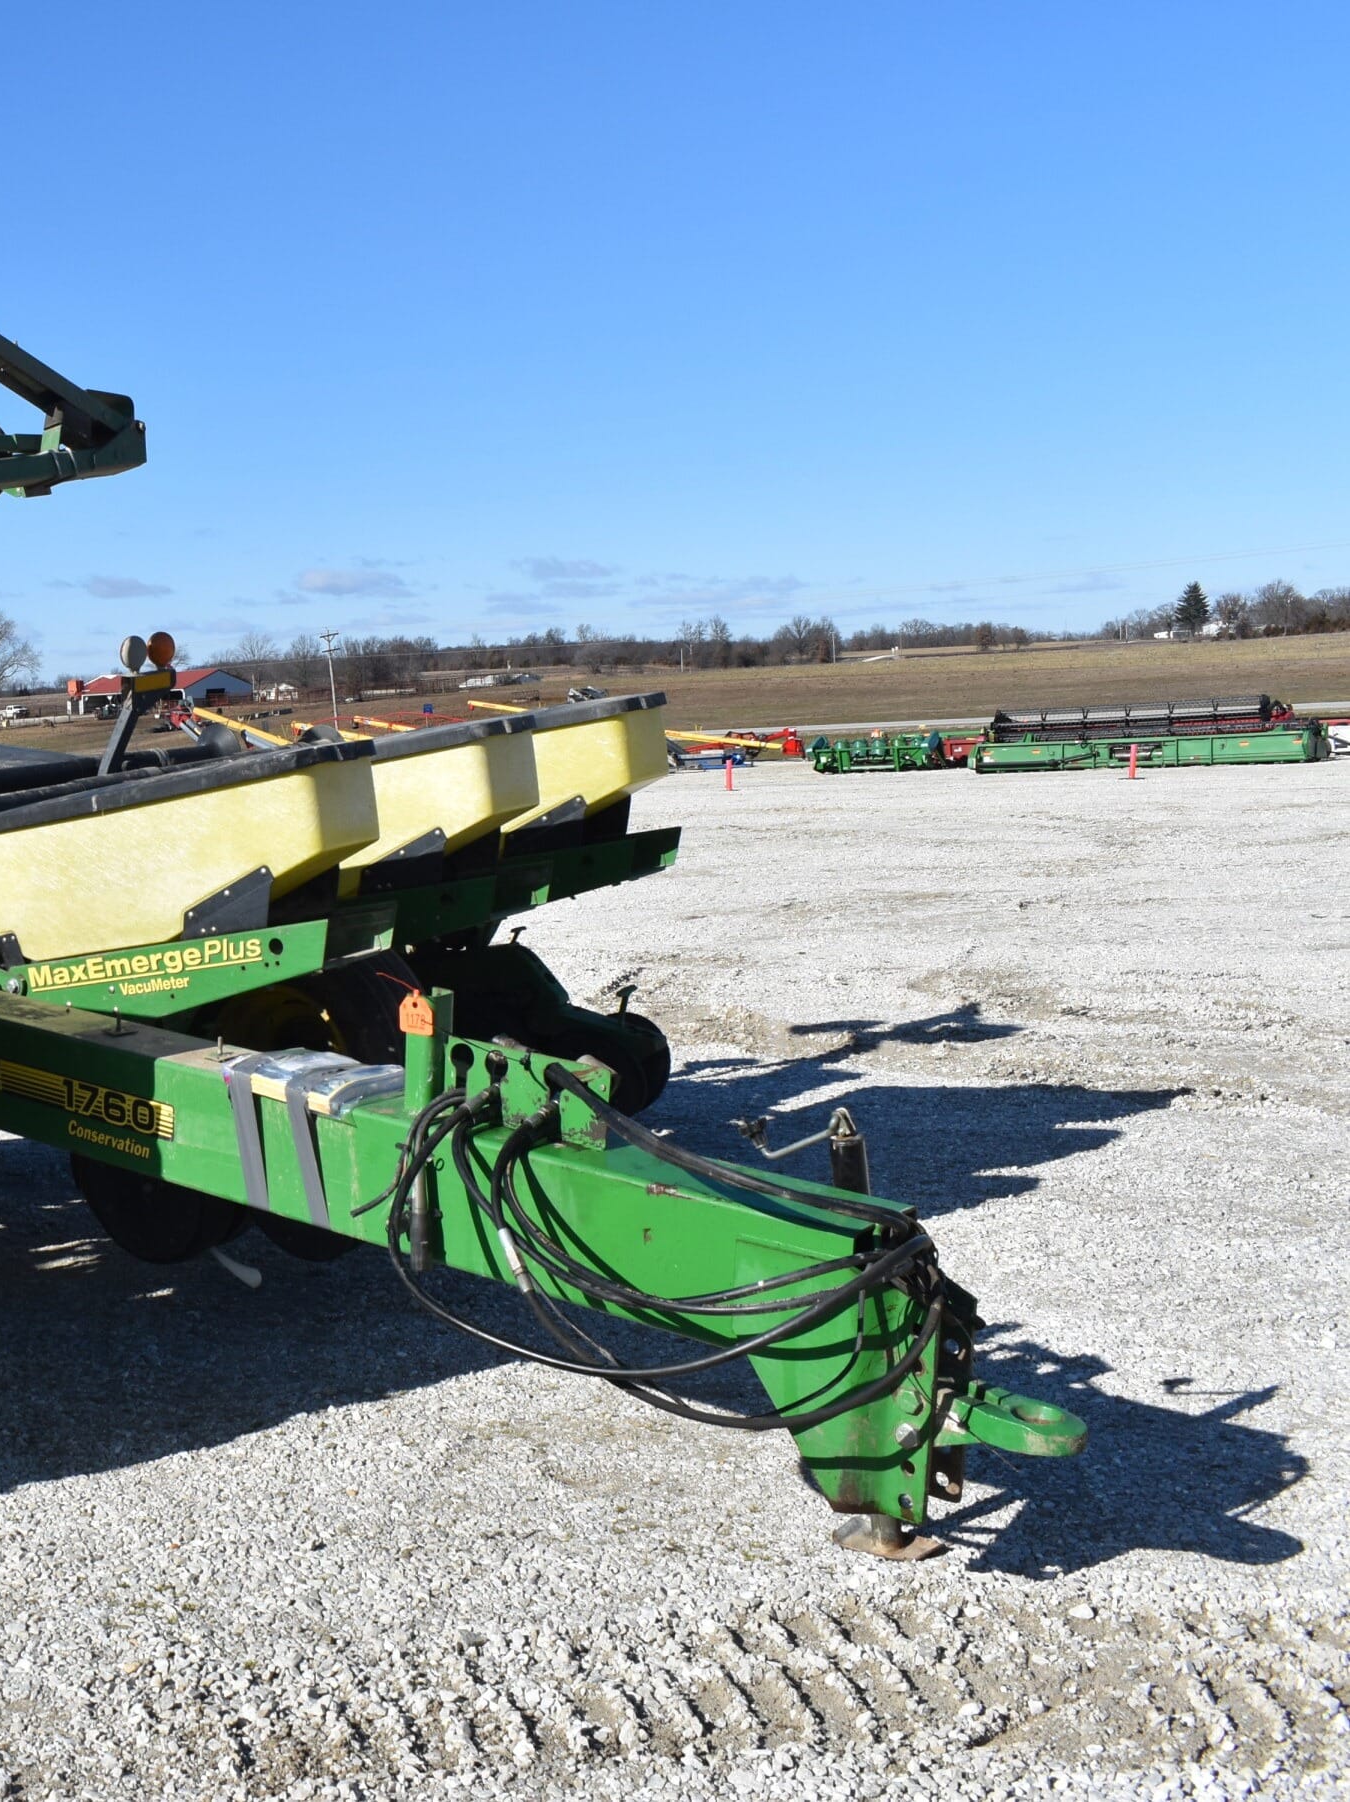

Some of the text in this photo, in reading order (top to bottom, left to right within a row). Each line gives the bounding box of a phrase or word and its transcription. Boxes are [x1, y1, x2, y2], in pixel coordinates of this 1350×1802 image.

[27, 938, 262, 988] MaxEmergePlus
[119, 976, 190, 996] VacuMeter
[62, 1079, 156, 1134] 1760
[68, 1120, 151, 1159] Conservation
